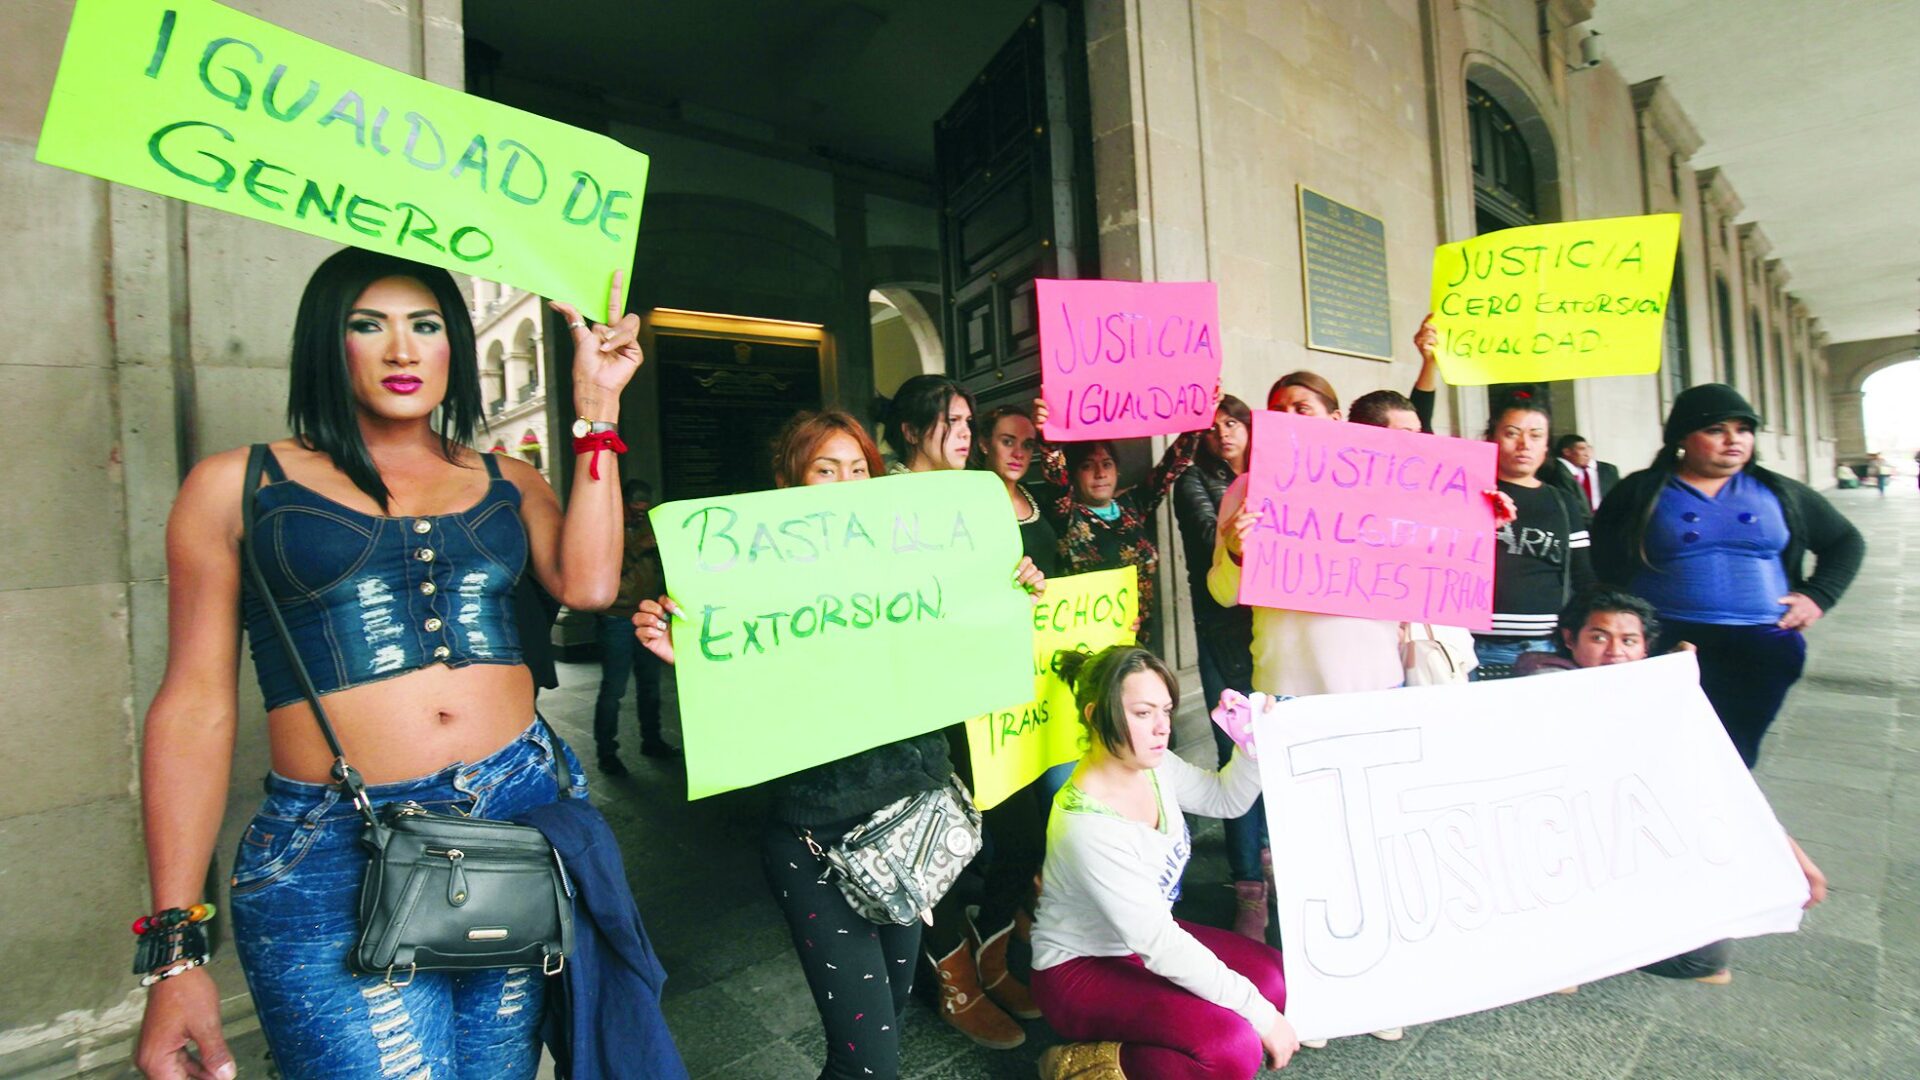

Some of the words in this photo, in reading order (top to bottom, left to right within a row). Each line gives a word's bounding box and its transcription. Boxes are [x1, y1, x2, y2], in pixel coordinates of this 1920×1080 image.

[563, 171, 634, 243] DE
[1447, 239, 1644, 288] JUSTICIA
[1055, 302, 1214, 374] JUSTICIA
[1441, 293, 1522, 318] CERO
[1065, 383, 1208, 430] IGUALDAD
[1275, 432, 1468, 500] JUSTICIA
[682, 506, 876, 573] BASTA
[1033, 587, 1128, 633] ECHOS
[1250, 541, 1410, 602] MUJERES
[1418, 566, 1491, 618] TRANS
